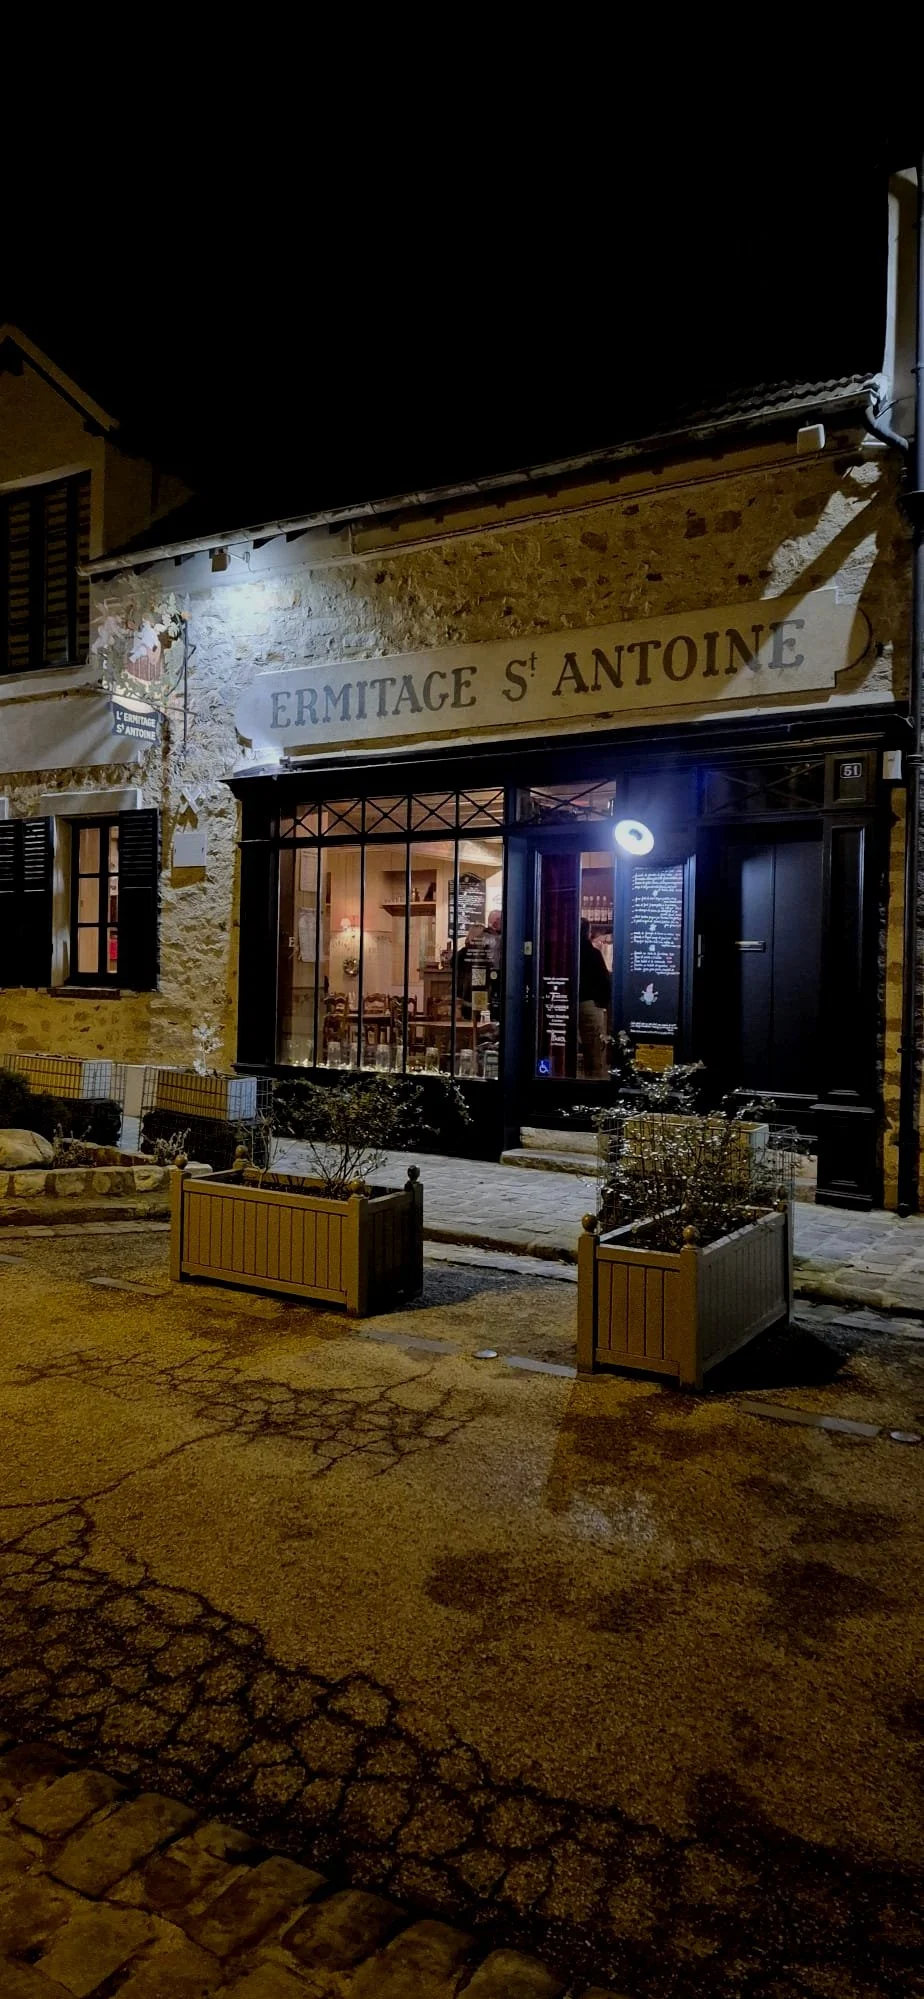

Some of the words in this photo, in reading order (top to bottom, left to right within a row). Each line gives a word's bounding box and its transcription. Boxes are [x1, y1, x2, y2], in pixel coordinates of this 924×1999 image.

[270, 666, 477, 729] ERMITAGE
[551, 618, 805, 696] ANTOINE
[116, 711, 156, 728] L'ERMITAGE
[125, 726, 156, 741] ANTOINE
[844, 765, 858, 777] 51
